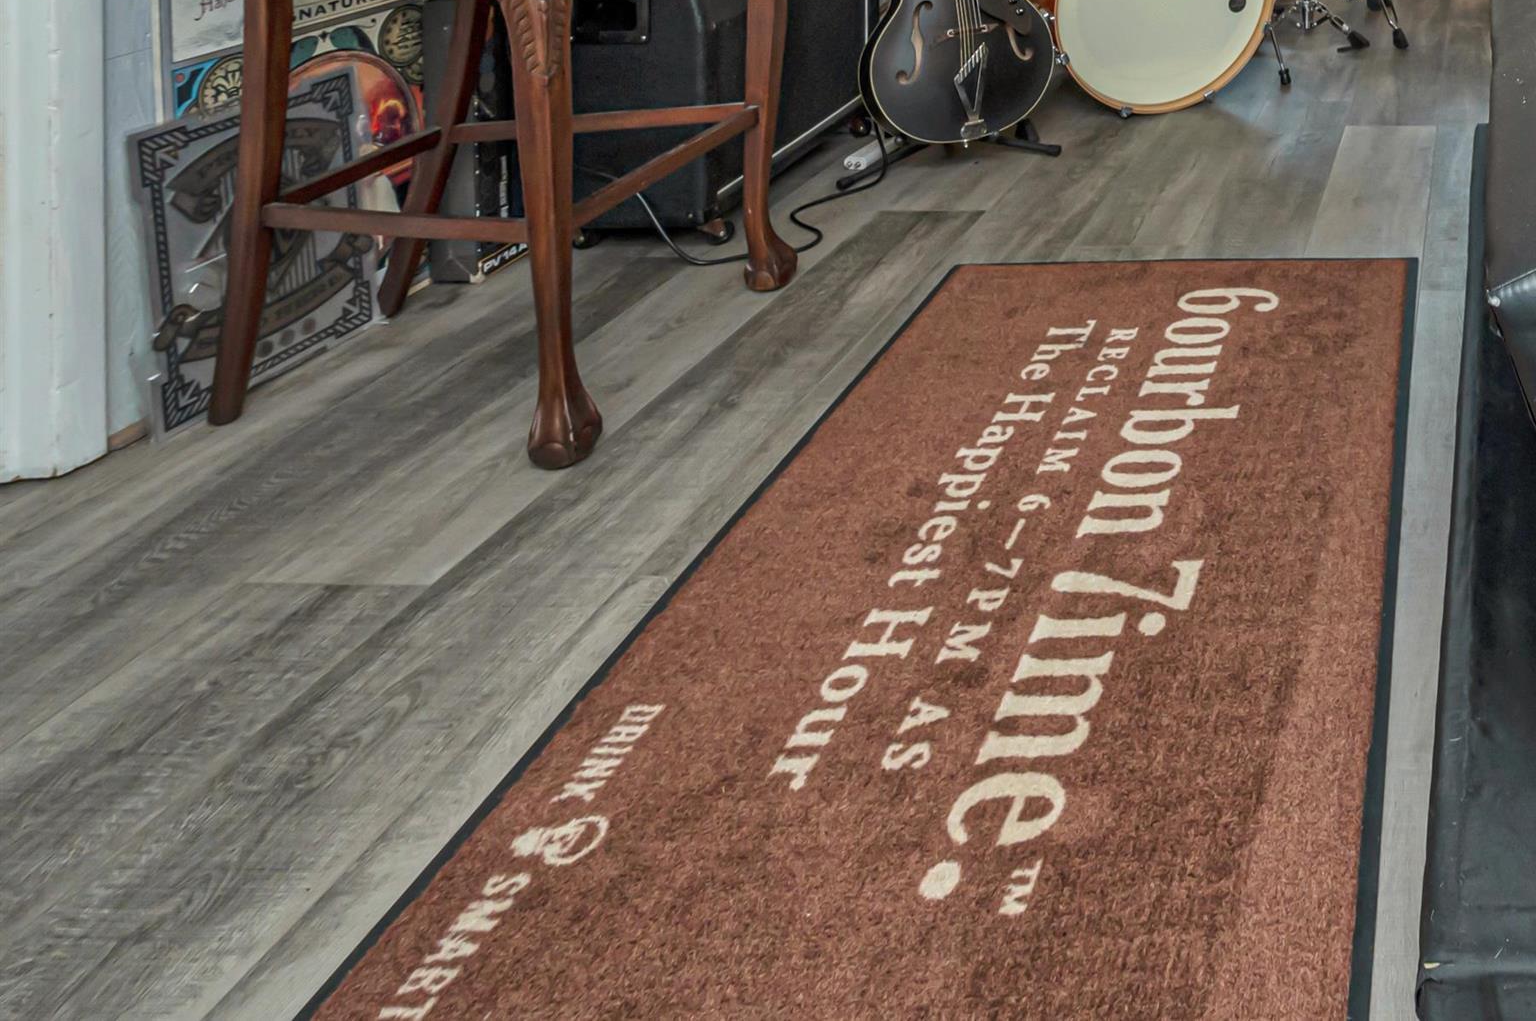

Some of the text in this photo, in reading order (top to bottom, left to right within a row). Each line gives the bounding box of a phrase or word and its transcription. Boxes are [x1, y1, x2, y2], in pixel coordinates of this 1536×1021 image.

[1036, 326, 1139, 475] RECLAIM
[767, 318, 1098, 792] The Happiest Hour
[549, 703, 667, 805] DRINK
[880, 696, 951, 771] AS
